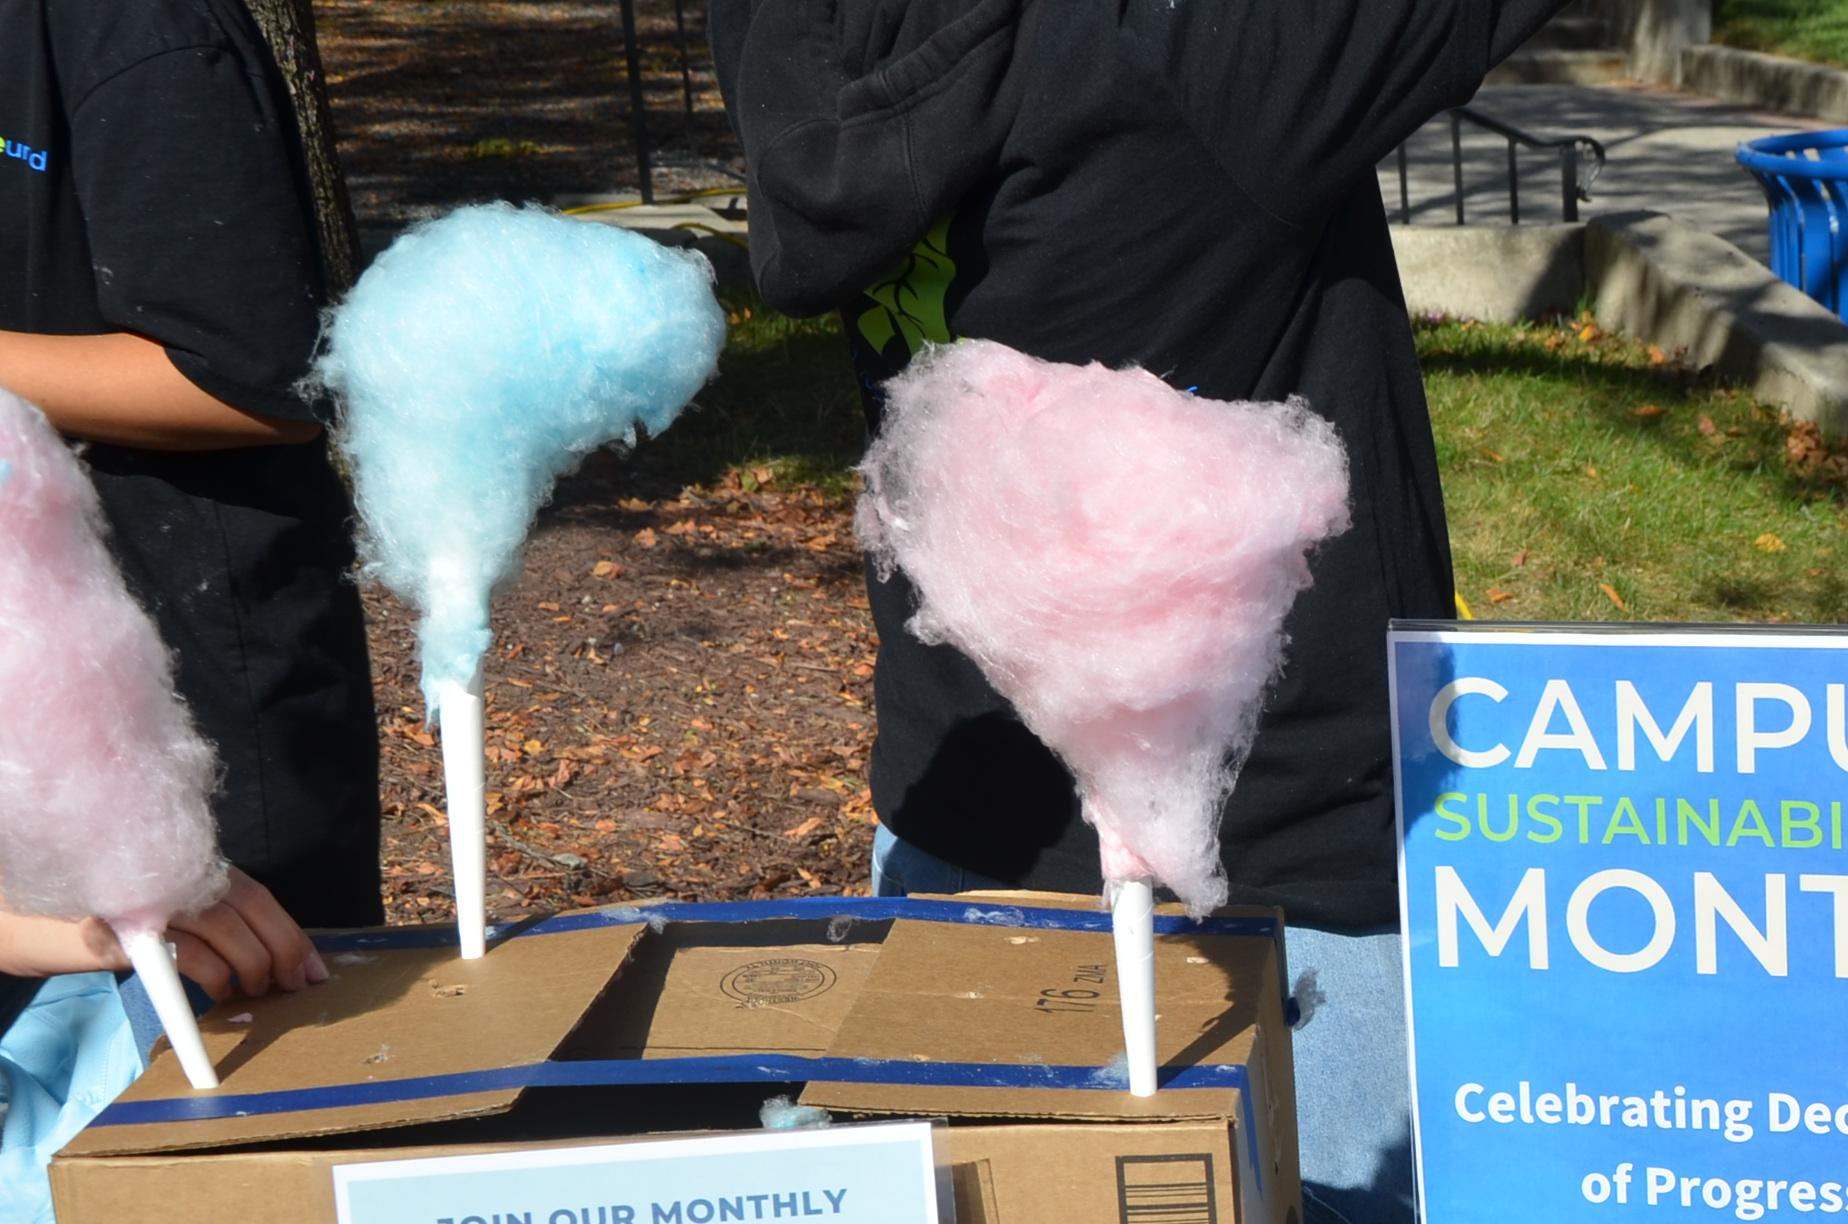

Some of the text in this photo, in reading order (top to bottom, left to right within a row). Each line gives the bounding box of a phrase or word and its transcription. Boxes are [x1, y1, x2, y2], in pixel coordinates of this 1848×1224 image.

[1033, 988, 1100, 1013] 176
[1454, 1081, 1755, 1142] Celebrating
[1581, 1164, 1635, 1206] of
